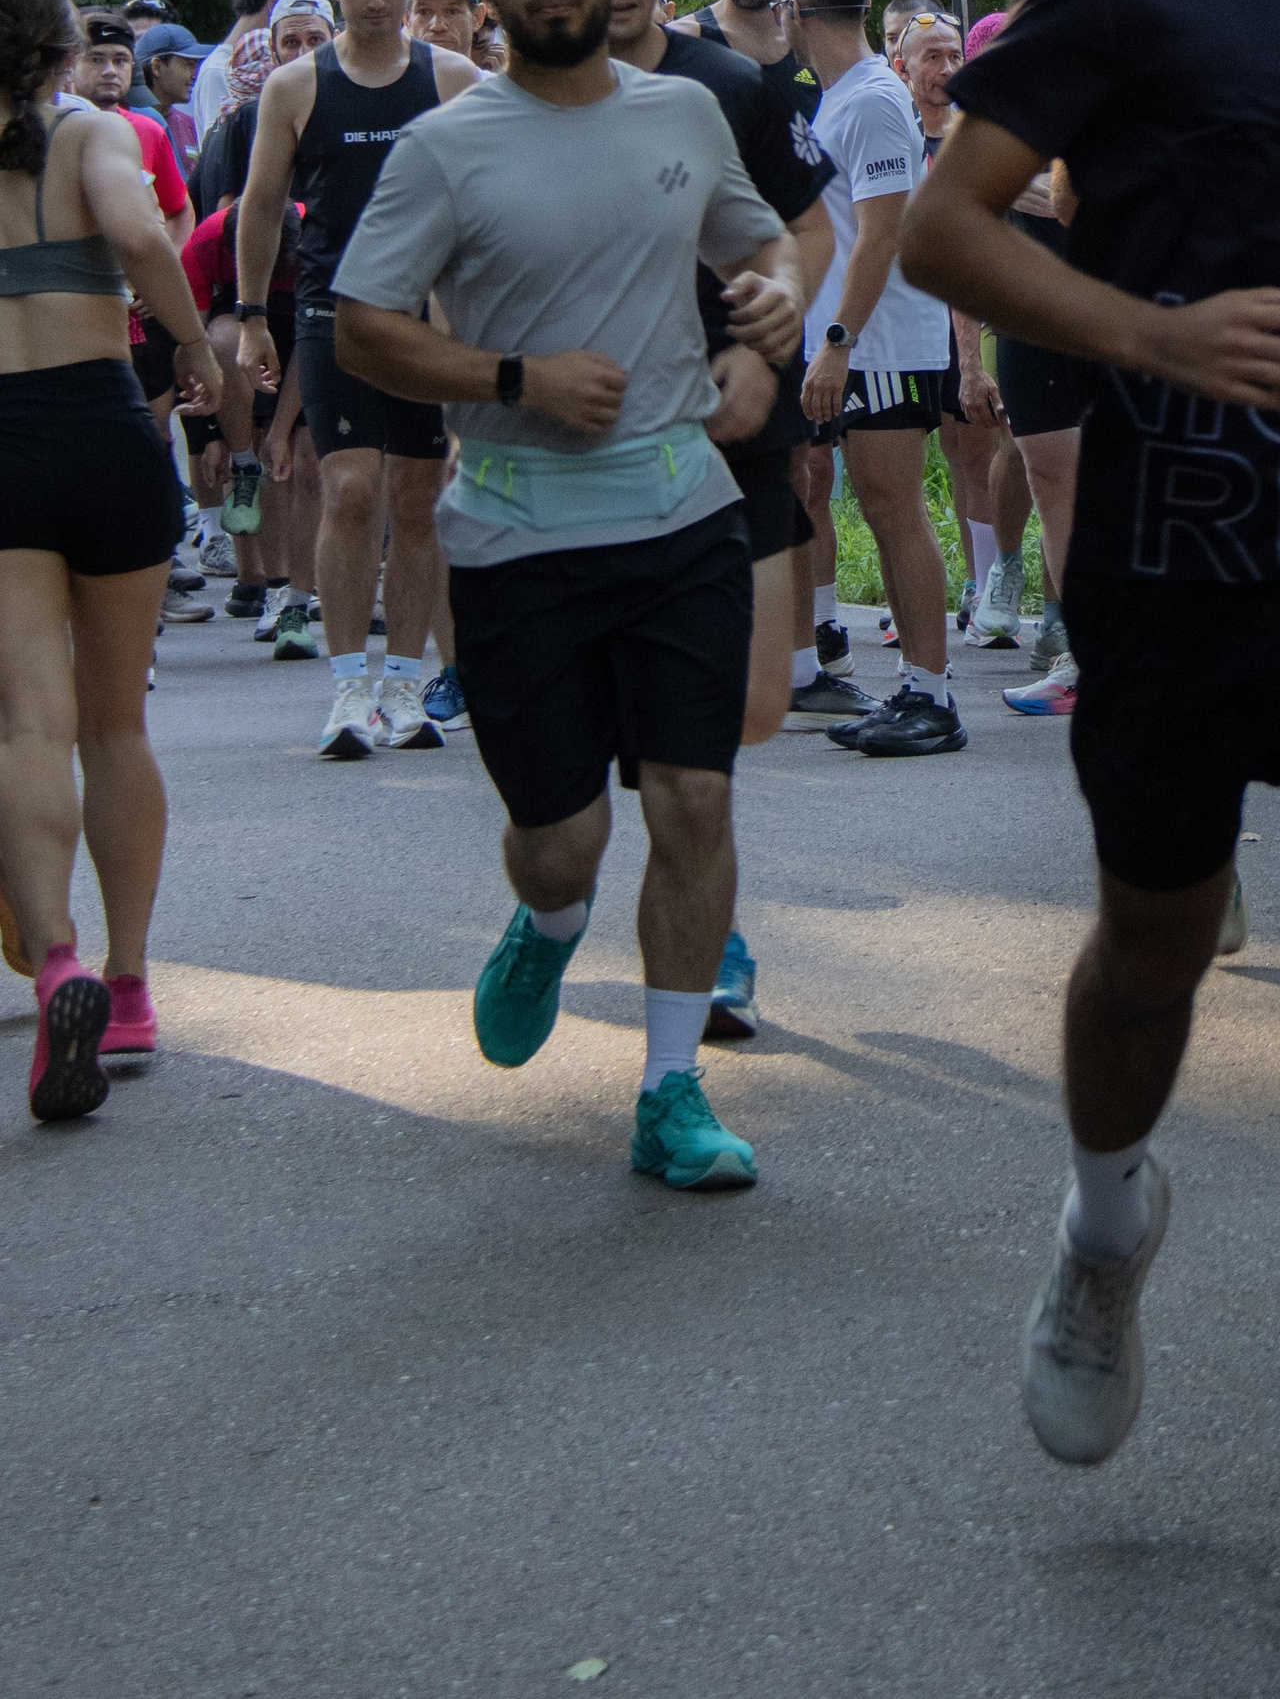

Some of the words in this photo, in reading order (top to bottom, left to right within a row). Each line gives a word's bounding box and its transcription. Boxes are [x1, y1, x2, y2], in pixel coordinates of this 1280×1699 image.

[344, 131, 368, 142] DIE
[866, 157, 906, 176] OMNIS
[868, 170, 907, 181] NUTRITION
